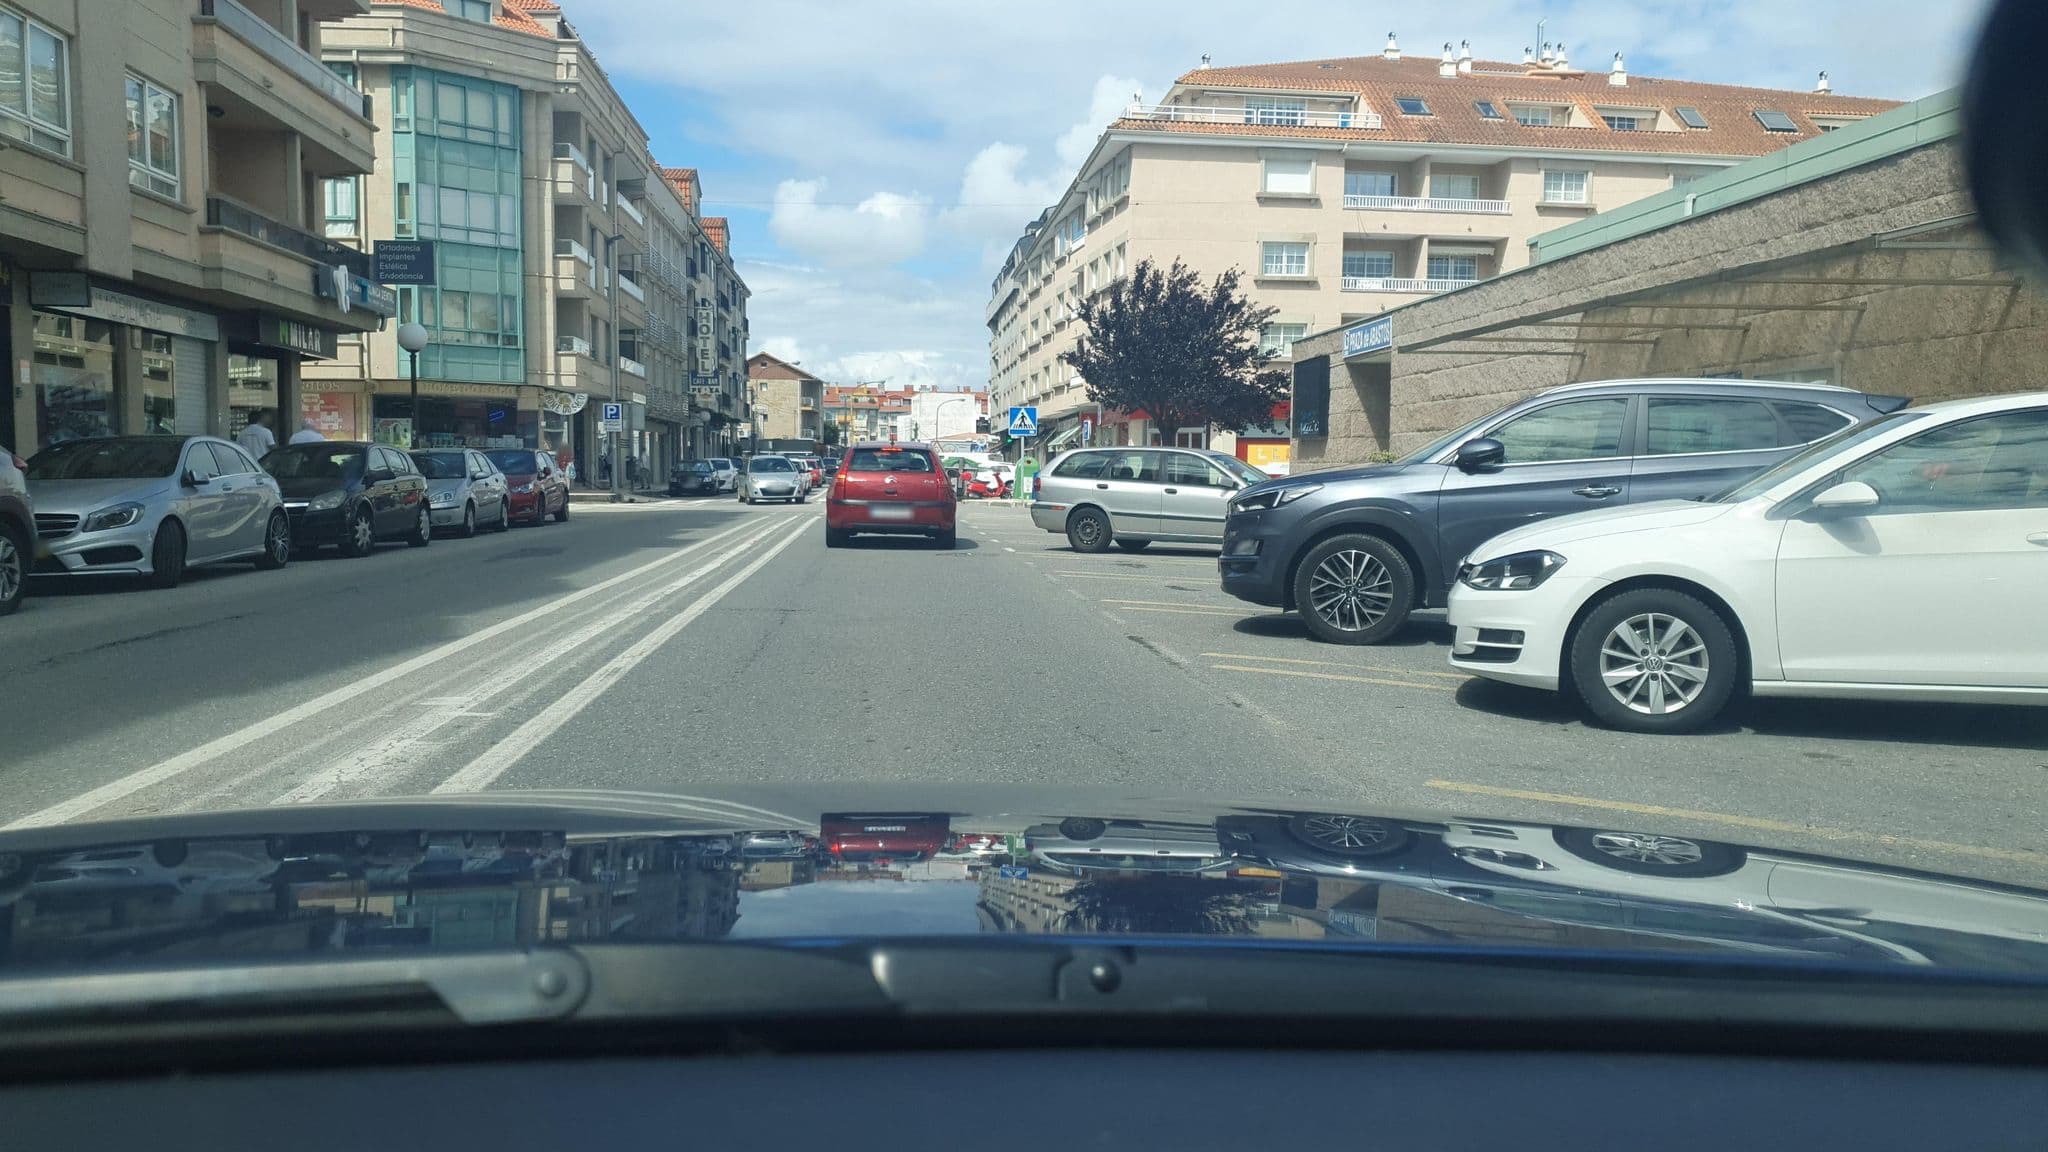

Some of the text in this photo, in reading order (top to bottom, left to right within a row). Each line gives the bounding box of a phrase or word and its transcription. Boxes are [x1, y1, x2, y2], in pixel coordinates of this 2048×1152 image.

[379, 243, 421, 252] Ortodoncia
[379, 253, 416, 262] Implantes
[379, 262, 408, 270] Estética
[379, 271, 424, 280] Endodoncia
[290, 322, 321, 353] MILAR
[698, 311, 711, 372] HOTEL
[606, 406, 617, 418] P
